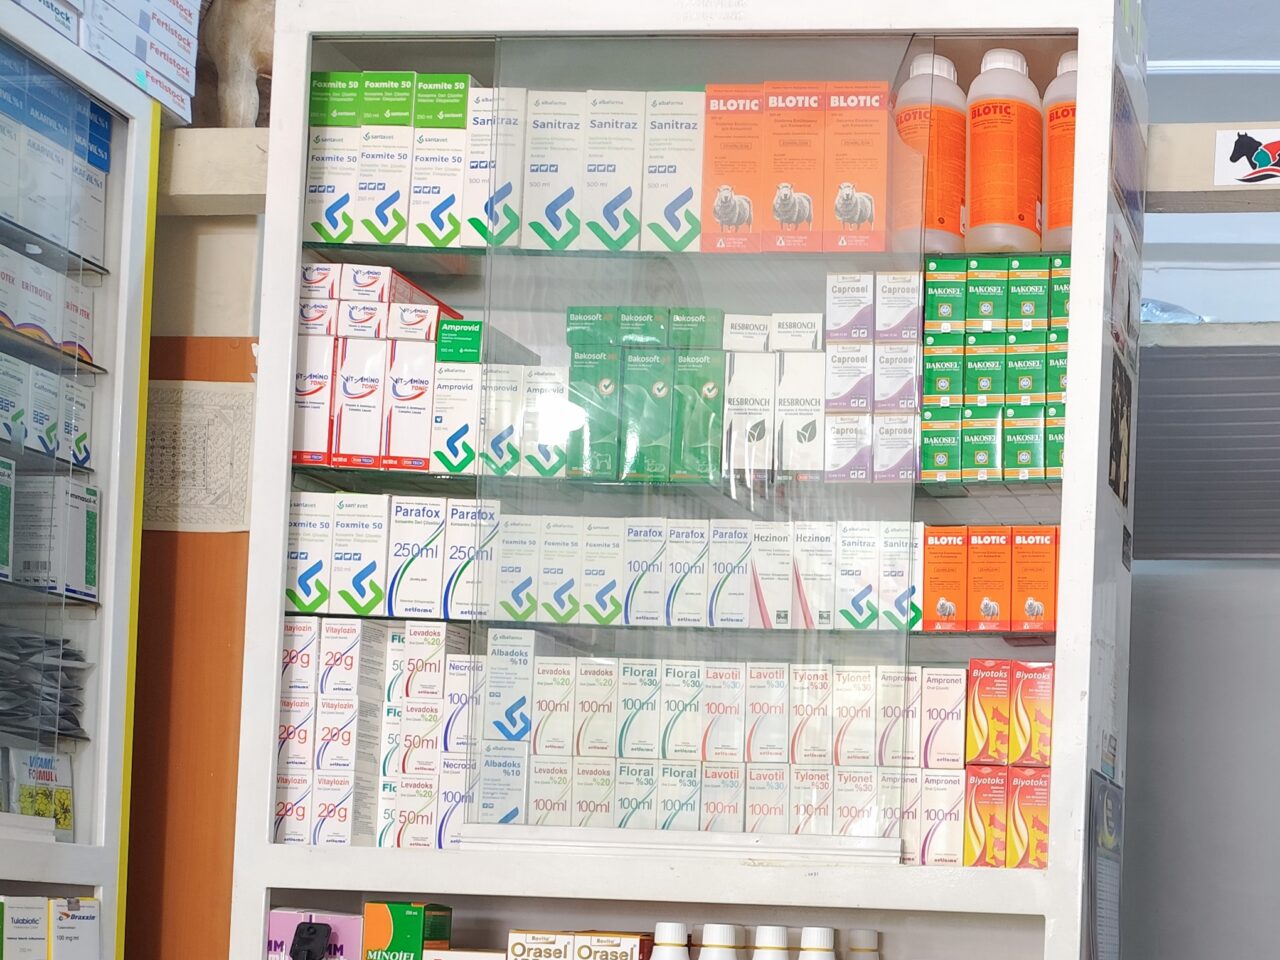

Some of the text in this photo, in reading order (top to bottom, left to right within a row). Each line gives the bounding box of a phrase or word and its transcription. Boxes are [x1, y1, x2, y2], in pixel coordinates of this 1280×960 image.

[151, 12, 192, 48] Fertistock
[149, 41, 191, 78] Fertistock
[145, 69, 185, 103] Fertistock
[364, 80, 411, 89] Foxmite 50
[417, 82, 465, 90] Foxmite 50
[709, 99, 760, 111] BLOTIC
[768, 95, 819, 108] BLOTIC
[830, 95, 880, 107] BLOTIC
[971, 105, 1011, 119] BLOTIC
[532, 119, 580, 130] Sanitraz
[589, 118, 638, 129] Sanitraz
[650, 120, 698, 130] Sanitraz
[831, 284, 868, 294] Caprosel
[928, 287, 962, 295] BAKOSEL
[569, 313, 602, 321] Bakosoft
[620, 313, 653, 322] Bakosoft
[441, 323, 480, 332] Amprovid
[730, 322, 768, 331] RESBRONCH
[777, 321, 816, 330] RESBRONCH
[574, 352, 607, 360] Bakosoft
[627, 355, 660, 363] Bakosoft
[678, 355, 711, 364] Bakosoft
[831, 355, 868, 364] Caprosel
[926, 361, 960, 369] BAKOSEL
[1008, 360, 1042, 368] BAKOSEL
[436, 383, 474, 392] Amprovid
[727, 397, 770, 406] RESBRONCH
[778, 397, 821, 406] RESBRONCH
[1007, 434, 1041, 442] BAKOSEL
[395, 505, 441, 519] Parafox
[450, 508, 495, 521] Parafox
[335, 521, 370, 529] Foxmite
[627, 528, 663, 538] Parafox
[669, 529, 705, 539] Parafox
[712, 530, 748, 540] Parafox
[753, 533, 789, 542] Hezinon
[796, 533, 831, 542] Hezinon
[841, 539, 876, 548] Sanitraz
[928, 536, 963, 545] BLOTIC
[971, 535, 1006, 544] BLOTIC
[1015, 535, 1050, 544] BLOTIC
[394, 543, 438, 559] 250ml
[325, 626, 357, 635] Vitaylozin
[409, 629, 441, 637] Levadoks
[423, 638, 441, 646] %20
[491, 648, 529, 658] Albadoks
[407, 658, 441, 673] 50ml
[509, 658, 528, 666] %10
[537, 668, 571, 676] Levadoks
[579, 668, 613, 677] Levadoks
[622, 666, 657, 678] Floral
[665, 667, 700, 679] Floral
[706, 670, 741, 681] Lavotil
[749, 669, 785, 680] Lavotil
[972, 669, 1008, 679] Biyotoks
[1016, 670, 1051, 680] Biyotoks
[639, 678, 658, 687] %30
[793, 672, 828, 683] Tylonet
[927, 676, 962, 686] Ampronet
[321, 701, 353, 710] Vitaylozin
[406, 705, 439, 714] Levadoks
[927, 707, 962, 721] 100ml
[404, 735, 438, 750] 50ml
[484, 759, 521, 769] Albadoks
[534, 766, 568, 775] Levadoks
[577, 768, 611, 776] Levadoks
[619, 765, 654, 777] Floral
[662, 767, 697, 778] Floral
[704, 769, 739, 779] Lavotil
[749, 771, 785, 781] Lavotil
[795, 771, 830, 782] Tylonet
[838, 773, 873, 784] Tylonet
[924, 776, 960, 786] Ampronet
[969, 776, 1005, 785] Biyotoks
[318, 777, 350, 787] Vitaylozin
[401, 782, 433, 790] Levadoks
[1012, 777, 1048, 787] Biyotoks
[399, 810, 433, 825] 50ml
[510, 942, 568, 959] Orasel
